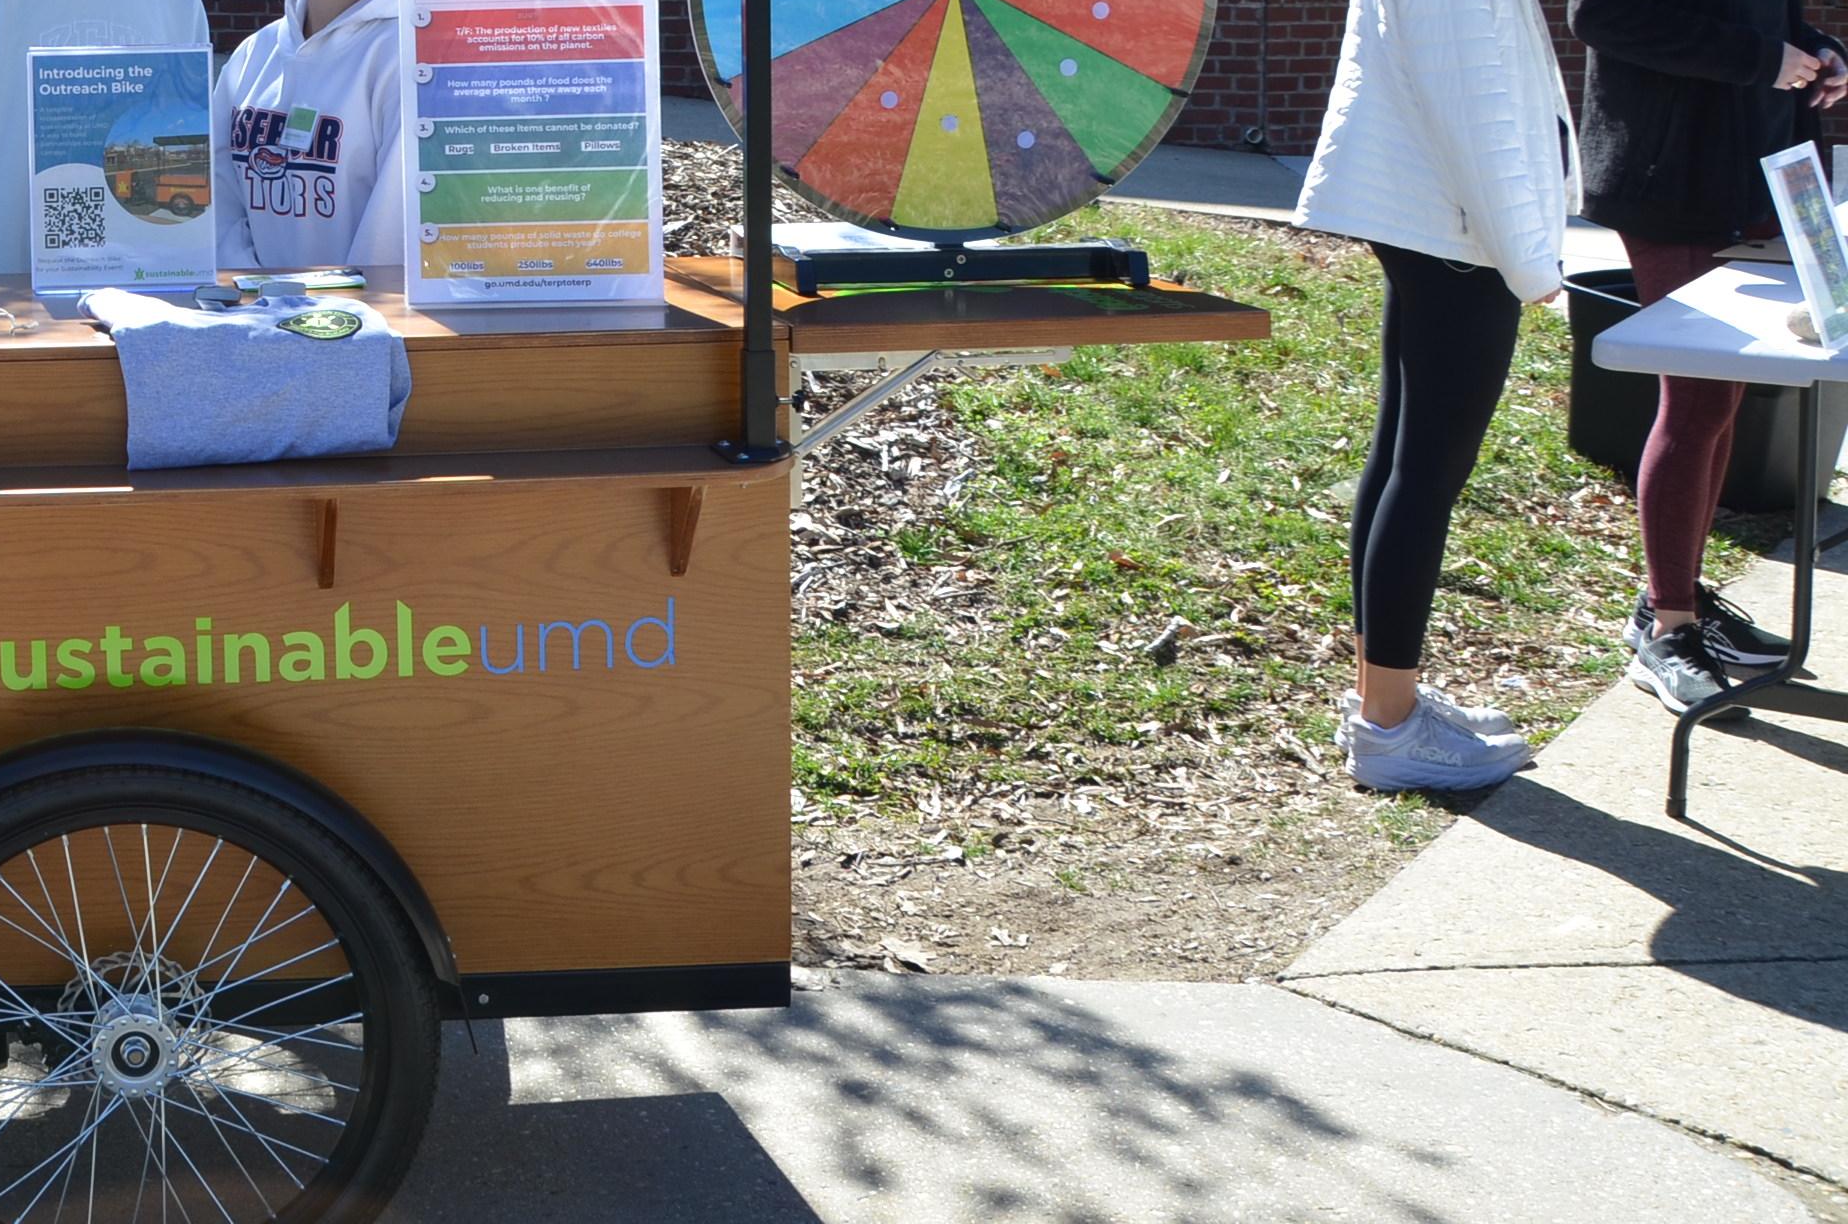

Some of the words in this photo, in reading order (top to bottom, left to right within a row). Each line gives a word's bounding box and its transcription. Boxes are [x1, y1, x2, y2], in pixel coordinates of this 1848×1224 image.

[417, 12, 425, 21] 1.
[455, 27, 473, 36] T/F:
[475, 26, 493, 35] The
[495, 24, 546, 36] production
[548, 24, 558, 33] of
[582, 23, 617, 32] textiles
[466, 35, 510, 44] accounts
[526, 33, 545, 41] 10%
[547, 32, 557, 41] of
[558, 32, 570, 41] all
[571, 32, 605, 41] carbon
[478, 43, 526, 52] emissions
[542, 41, 558, 50] the
[560, 41, 593, 51] planet.
[38, 66, 124, 80] Introducing
[128, 65, 153, 78] the
[418, 69, 427, 77] 2.
[39, 82, 107, 96] Outreach
[111, 81, 144, 94] Bike
[447, 79, 469, 88] How
[471, 79, 497, 89] many
[499, 77, 535, 88] pounds
[537, 77, 547, 85] of
[548, 77, 570, 85] food
[572, 76, 594, 85] does
[596, 76, 613, 84] the
[453, 87, 491, 97] average
[492, 87, 525, 97] person
[527, 86, 555, 94] throw
[557, 86, 582, 95] away
[583, 85, 607, 93] each
[511, 94, 543, 103] month
[444, 124, 475, 135] Which
[476, 124, 488, 134] of
[489, 123, 516, 134] these
[545, 122, 579, 132] cannot
[580, 122, 593, 131] be
[594, 121, 640, 131] donated?
[448, 145, 474, 155] Rugs
[494, 143, 530, 152] Broken
[532, 142, 561, 152] Items
[584, 141, 621, 151] Pillows
[487, 184, 514, 194] What
[515, 184, 523, 194] is
[526, 186, 543, 194] one
[545, 183, 578, 193] benefit
[579, 183, 591, 192] of
[481, 193, 522, 203] reducing
[525, 193, 543, 202] and
[545, 192, 586, 203] reusing?
[425, 228, 433, 237] 5.
[608, 228, 642, 240] college
[484, 278, 592, 290] go.umd.edu/terptoterp
